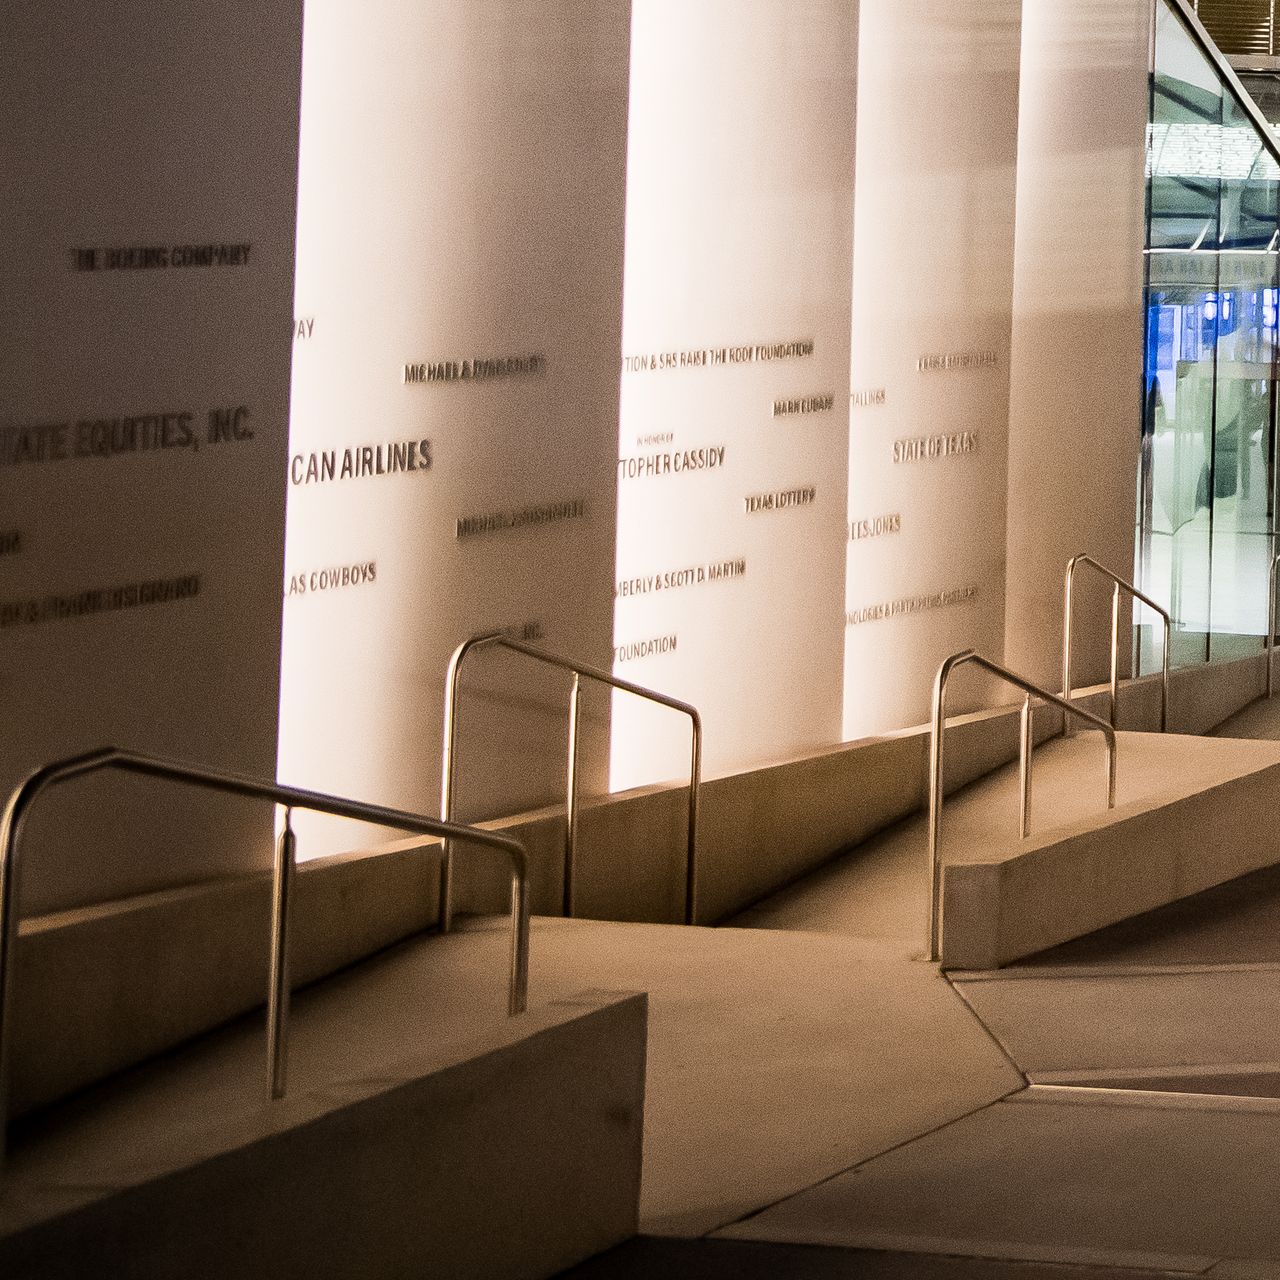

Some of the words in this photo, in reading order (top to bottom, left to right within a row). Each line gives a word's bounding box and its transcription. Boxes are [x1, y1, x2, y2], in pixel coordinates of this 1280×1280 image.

[171, 243, 252, 268] COMPANY
[294, 319, 314, 340] AY
[650, 354, 657, 370] &
[659, 352, 678, 369] SRS
[680, 350, 706, 367] RAISE
[709, 348, 726, 365] THE
[729, 346, 753, 362] ROOF
[755, 340, 814, 361] FOUNDATION
[74, 411, 199, 458] EQUITIES,
[208, 405, 254, 444] INC.
[291, 450, 335, 486] CAN
[340, 438, 432, 480] AIRLINES
[673, 446, 725, 473] CASSIDY
[893, 438, 926, 463] STATE
[926, 437, 941, 458] OF
[941, 431, 978, 457] TEXAS
[744, 494, 773, 513] TEXAS
[775, 488, 816, 509] LOTTERY
[285, 574, 306, 597] AS
[310, 561, 377, 592] COWBOYS
[655, 574, 662, 591] &
[664, 568, 695, 589] SCOTT
[708, 560, 747, 580] MARTIN
